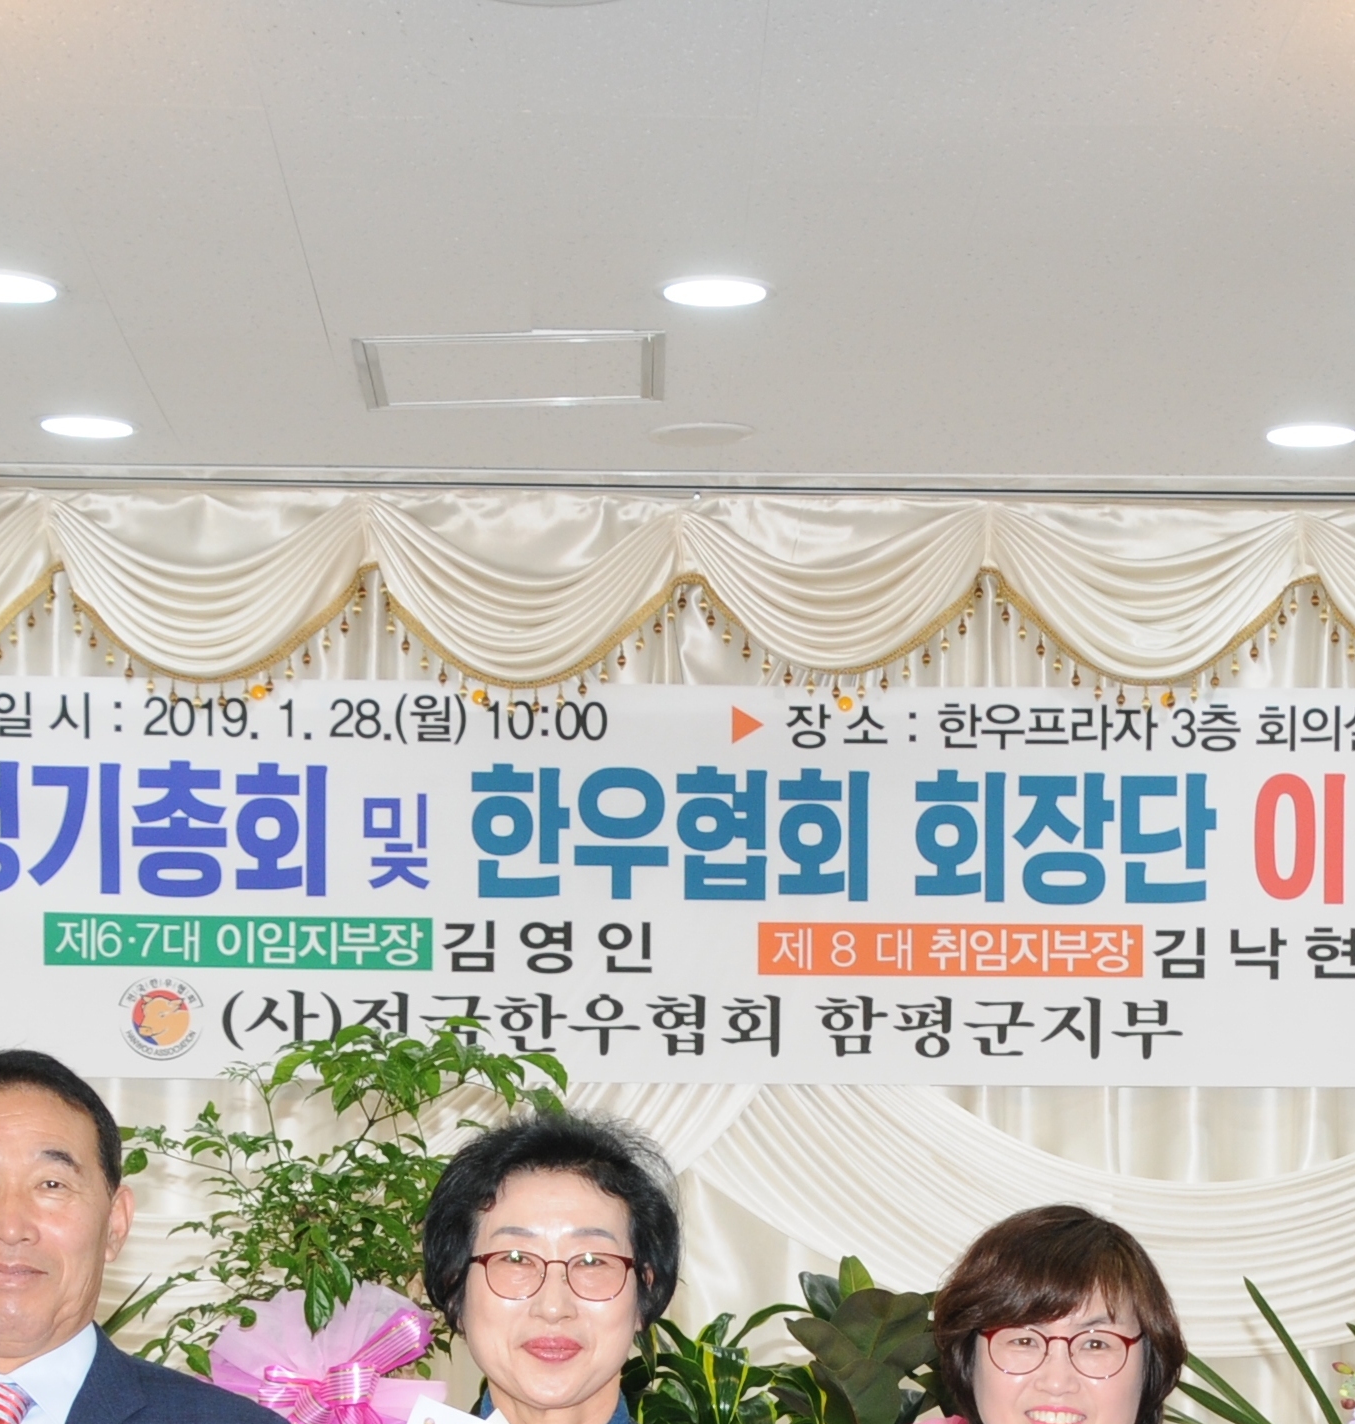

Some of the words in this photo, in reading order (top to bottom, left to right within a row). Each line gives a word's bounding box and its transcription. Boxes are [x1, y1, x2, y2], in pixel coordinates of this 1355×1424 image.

[486, 699, 609, 741] 10:00
[938, 700, 1158, 751] 한우프라자
[1168, 702, 1241, 752] 3층
[361, 792, 431, 892] 및
[469, 762, 871, 904] 한우협회
[912, 767, 1219, 907] 회장단
[1252, 771, 1347, 906] 이
[215, 921, 425, 966] 이임지부장
[927, 928, 1135, 975] 취임지부장
[816, 995, 1183, 1060] 함평군지부
